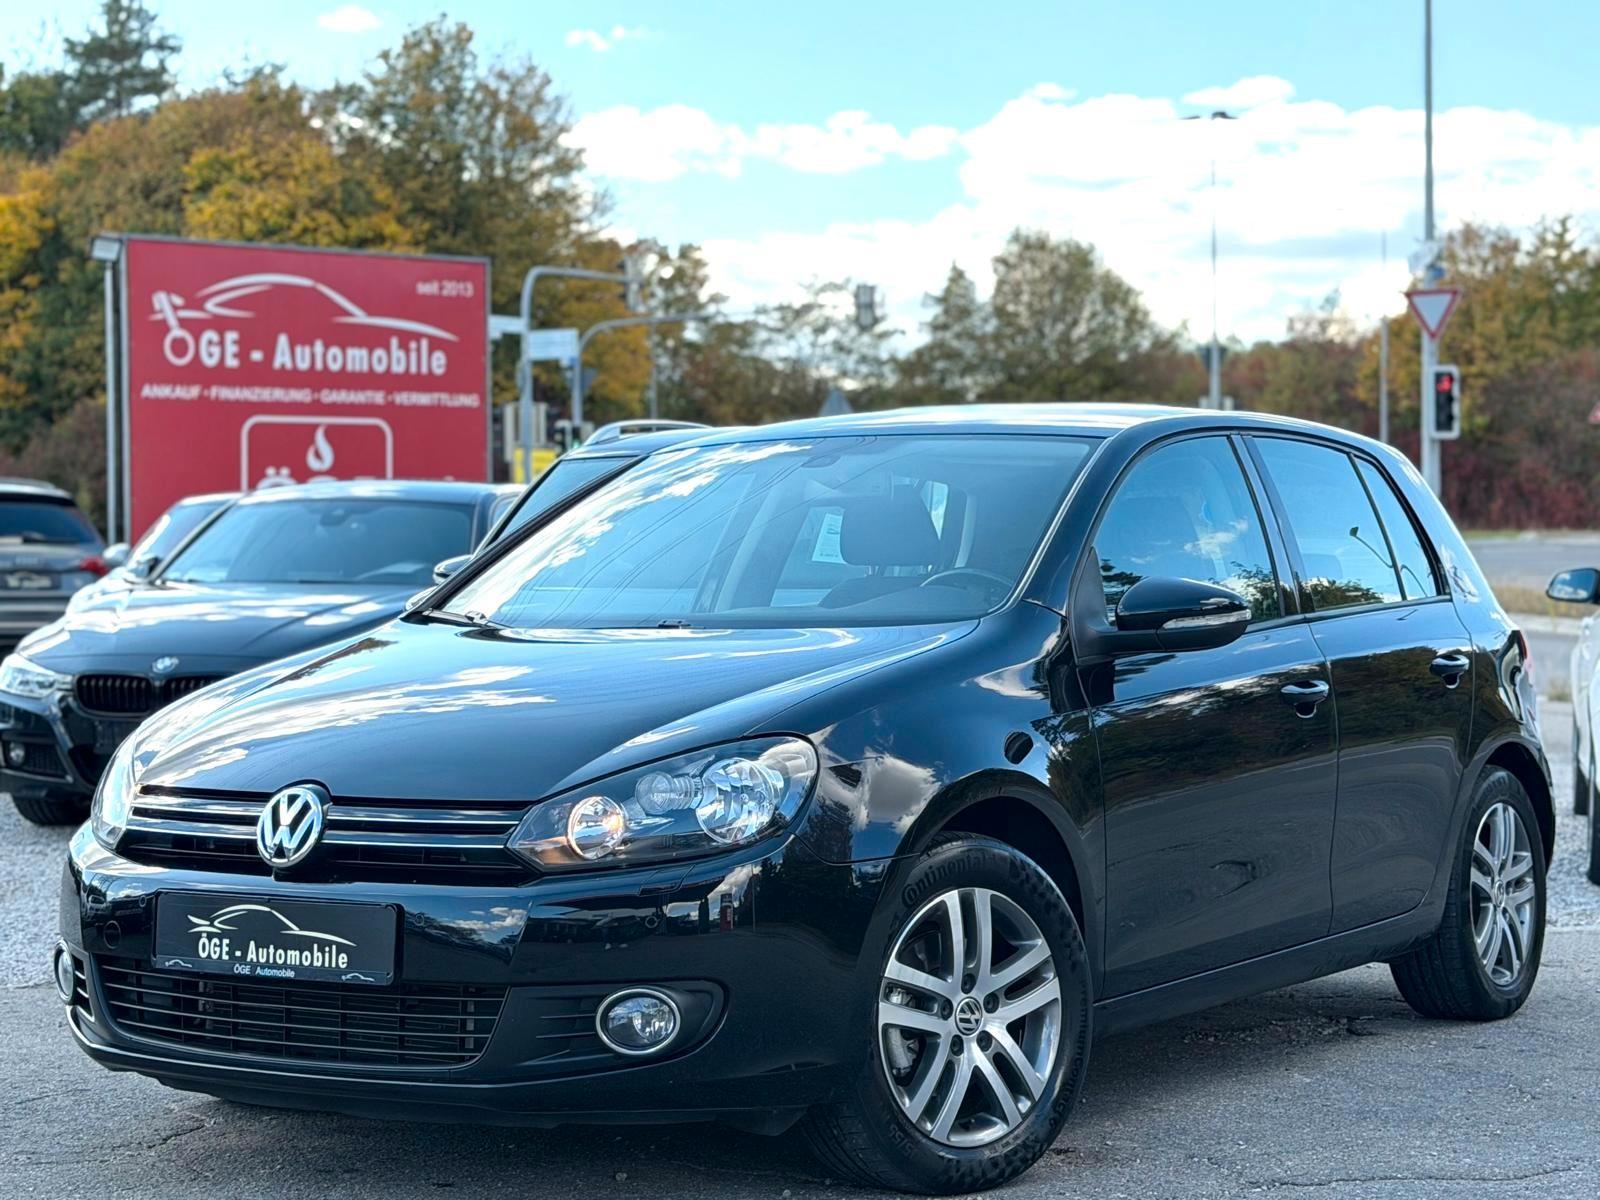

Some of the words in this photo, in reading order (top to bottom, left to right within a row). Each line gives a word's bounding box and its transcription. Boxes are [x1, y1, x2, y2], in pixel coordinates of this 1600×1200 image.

[416, 280, 439, 295] seit
[441, 280, 474, 297] 2013
[273, 333, 447, 376] Automobile
[141, 383, 201, 400] ANKAUF
[210, 385, 312, 403] FINANZIERUNG
[319, 388, 386, 405] GARANTIE
[393, 391, 480, 408] VERMITTLUNG
[901, 852, 986, 907] Continental
[198, 933, 230, 960] ÖGE
[246, 940, 349, 969] Automobile
[233, 963, 251, 975] ÖGE
[255, 966, 295, 978] Automobile
